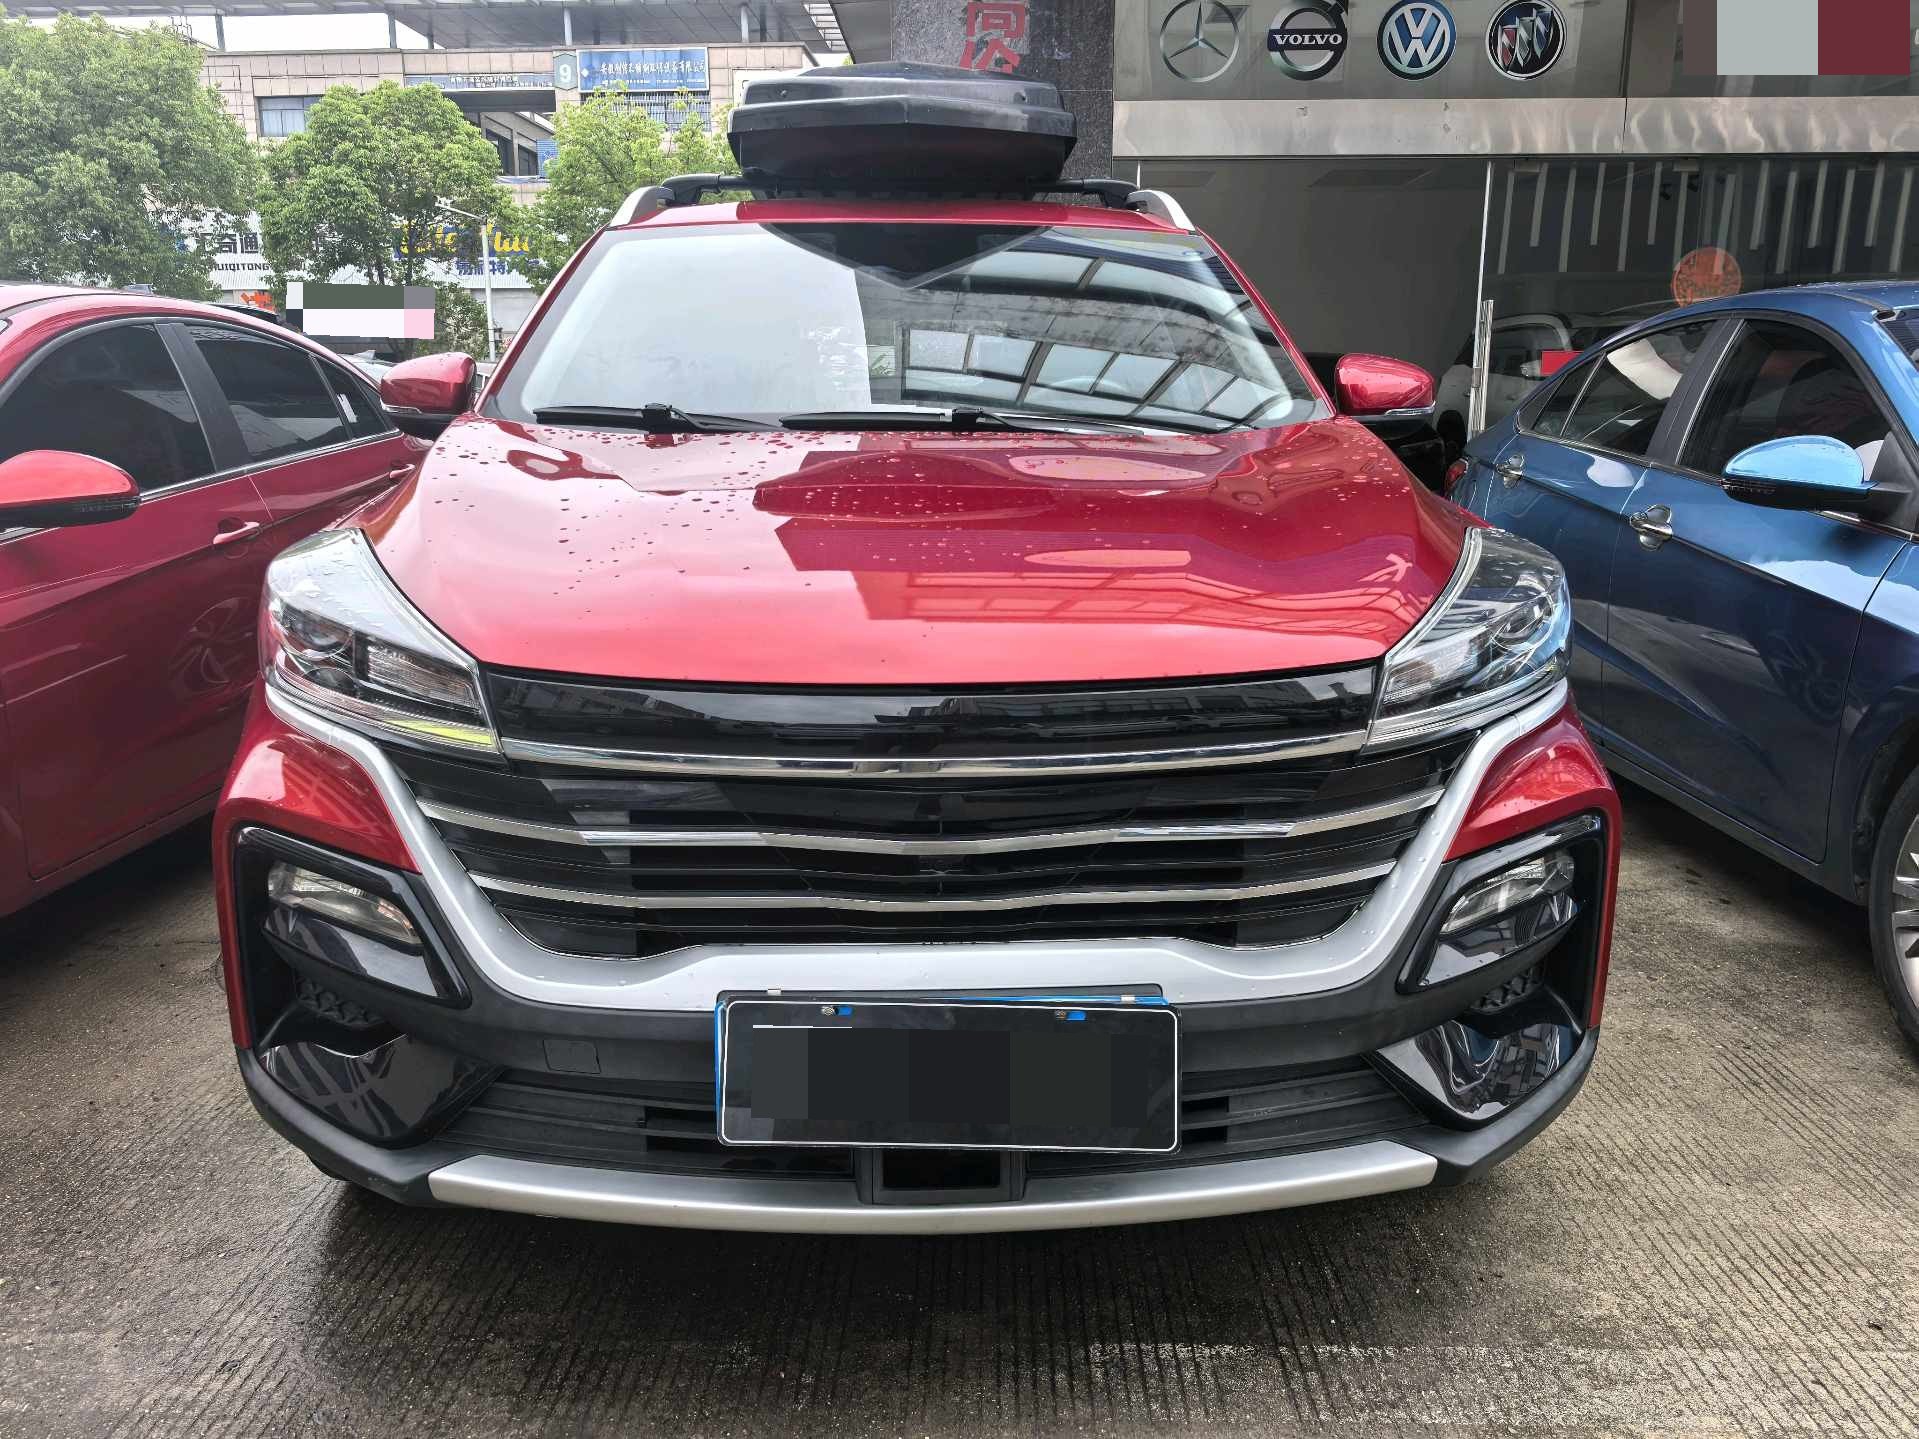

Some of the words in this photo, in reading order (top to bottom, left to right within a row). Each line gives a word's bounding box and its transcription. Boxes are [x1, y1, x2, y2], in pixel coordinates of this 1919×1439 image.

[1272, 33, 1343, 46] VOLVO
[560, 64, 571, 82] 9
[210, 262, 270, 272] UIQITONG
